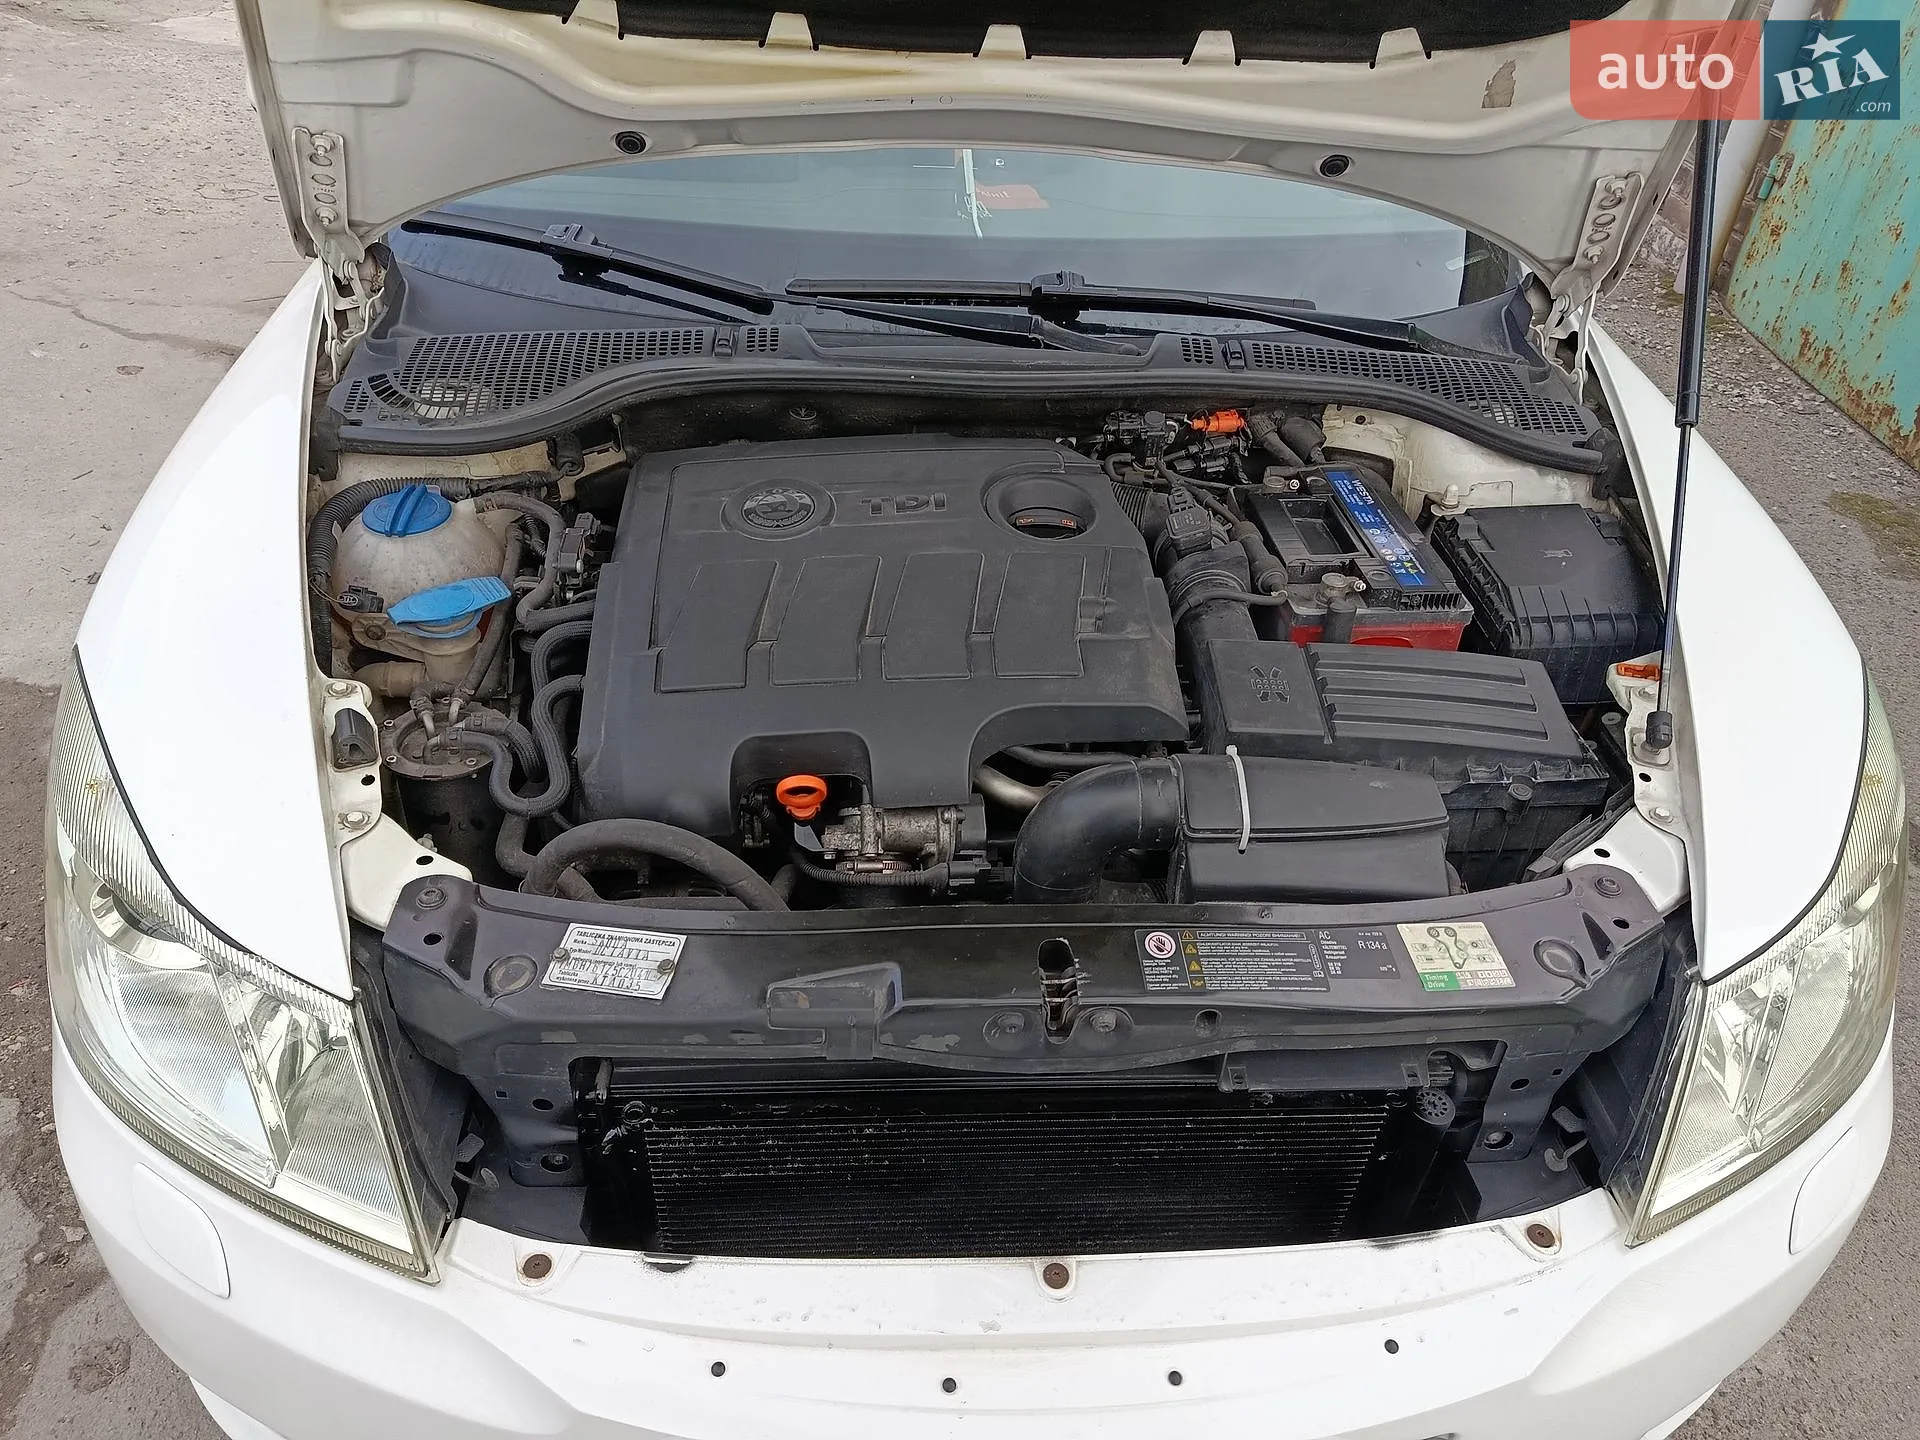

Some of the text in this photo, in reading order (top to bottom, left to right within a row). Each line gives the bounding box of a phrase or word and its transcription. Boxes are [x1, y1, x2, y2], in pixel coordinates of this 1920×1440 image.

[1351, 479, 1375, 505] WESTA
[859, 491, 947, 517] TDI
[1318, 930, 1331, 940] AC
[1424, 974, 1449, 982] Timing
